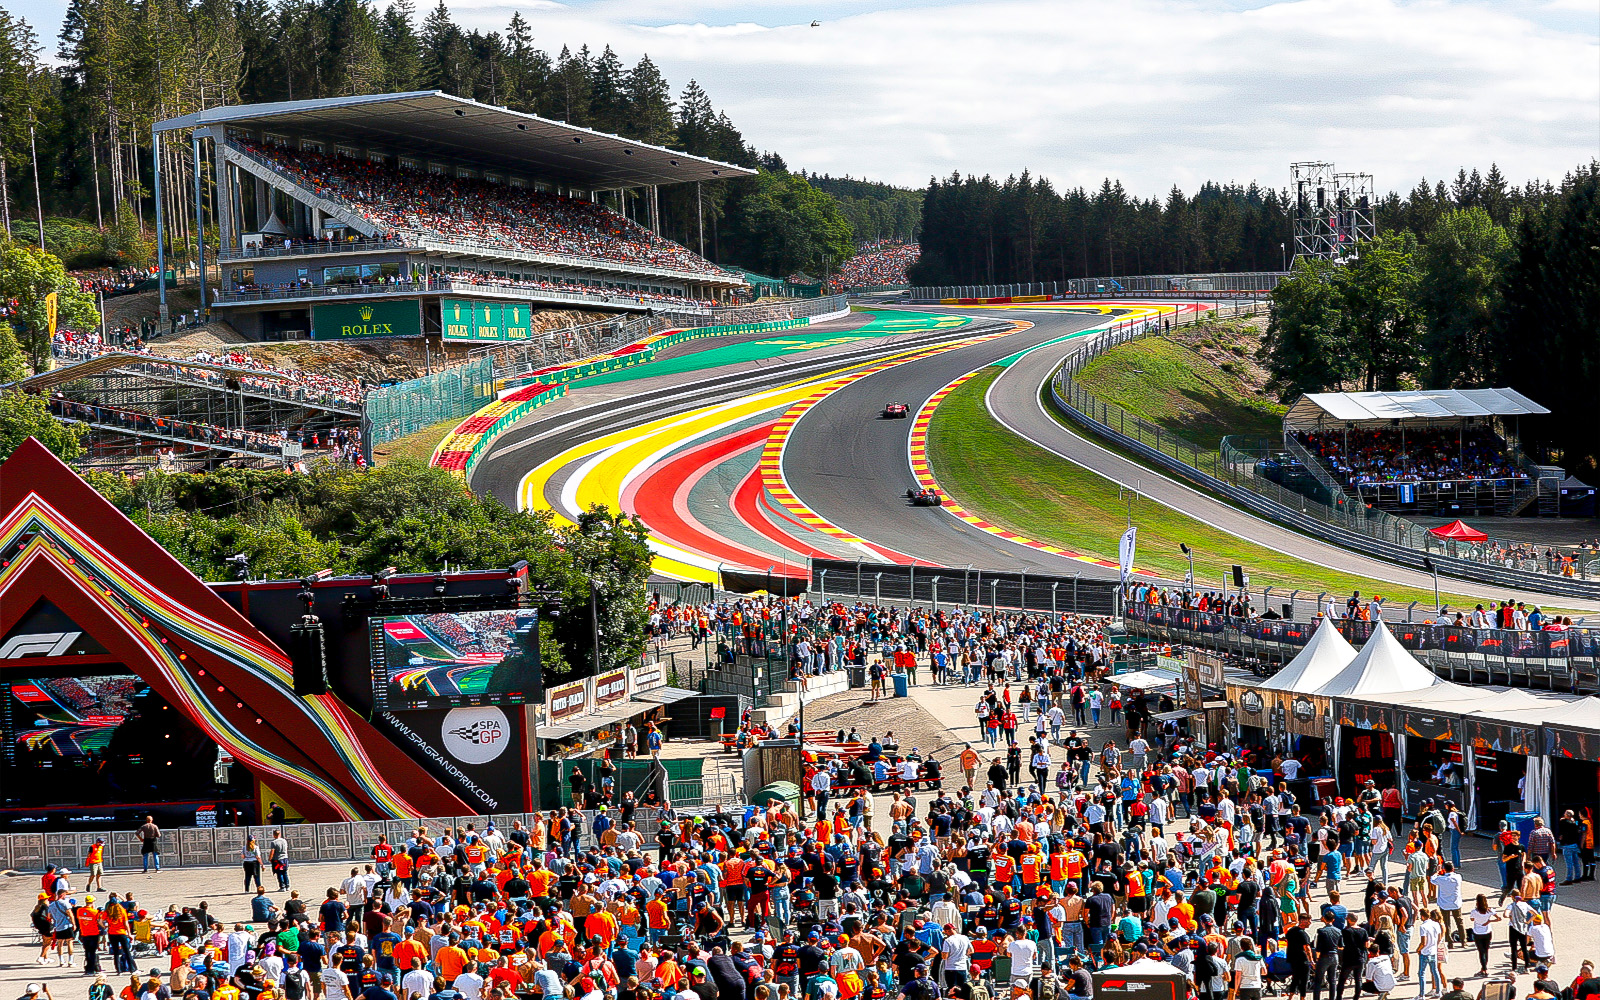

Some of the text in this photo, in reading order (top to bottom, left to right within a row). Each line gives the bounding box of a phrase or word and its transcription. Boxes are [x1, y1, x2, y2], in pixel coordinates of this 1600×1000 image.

[341, 323, 393, 336] ROLEX
[447, 324, 469, 337] ROLEX
[478, 326, 498, 338] ROLEX
[508, 327, 526, 338] ROLEX
[479, 720, 501, 730] SPA
[480, 730, 502, 744] GP
[382, 710, 498, 809] WWW.SPAGRANDPRIX.COM
